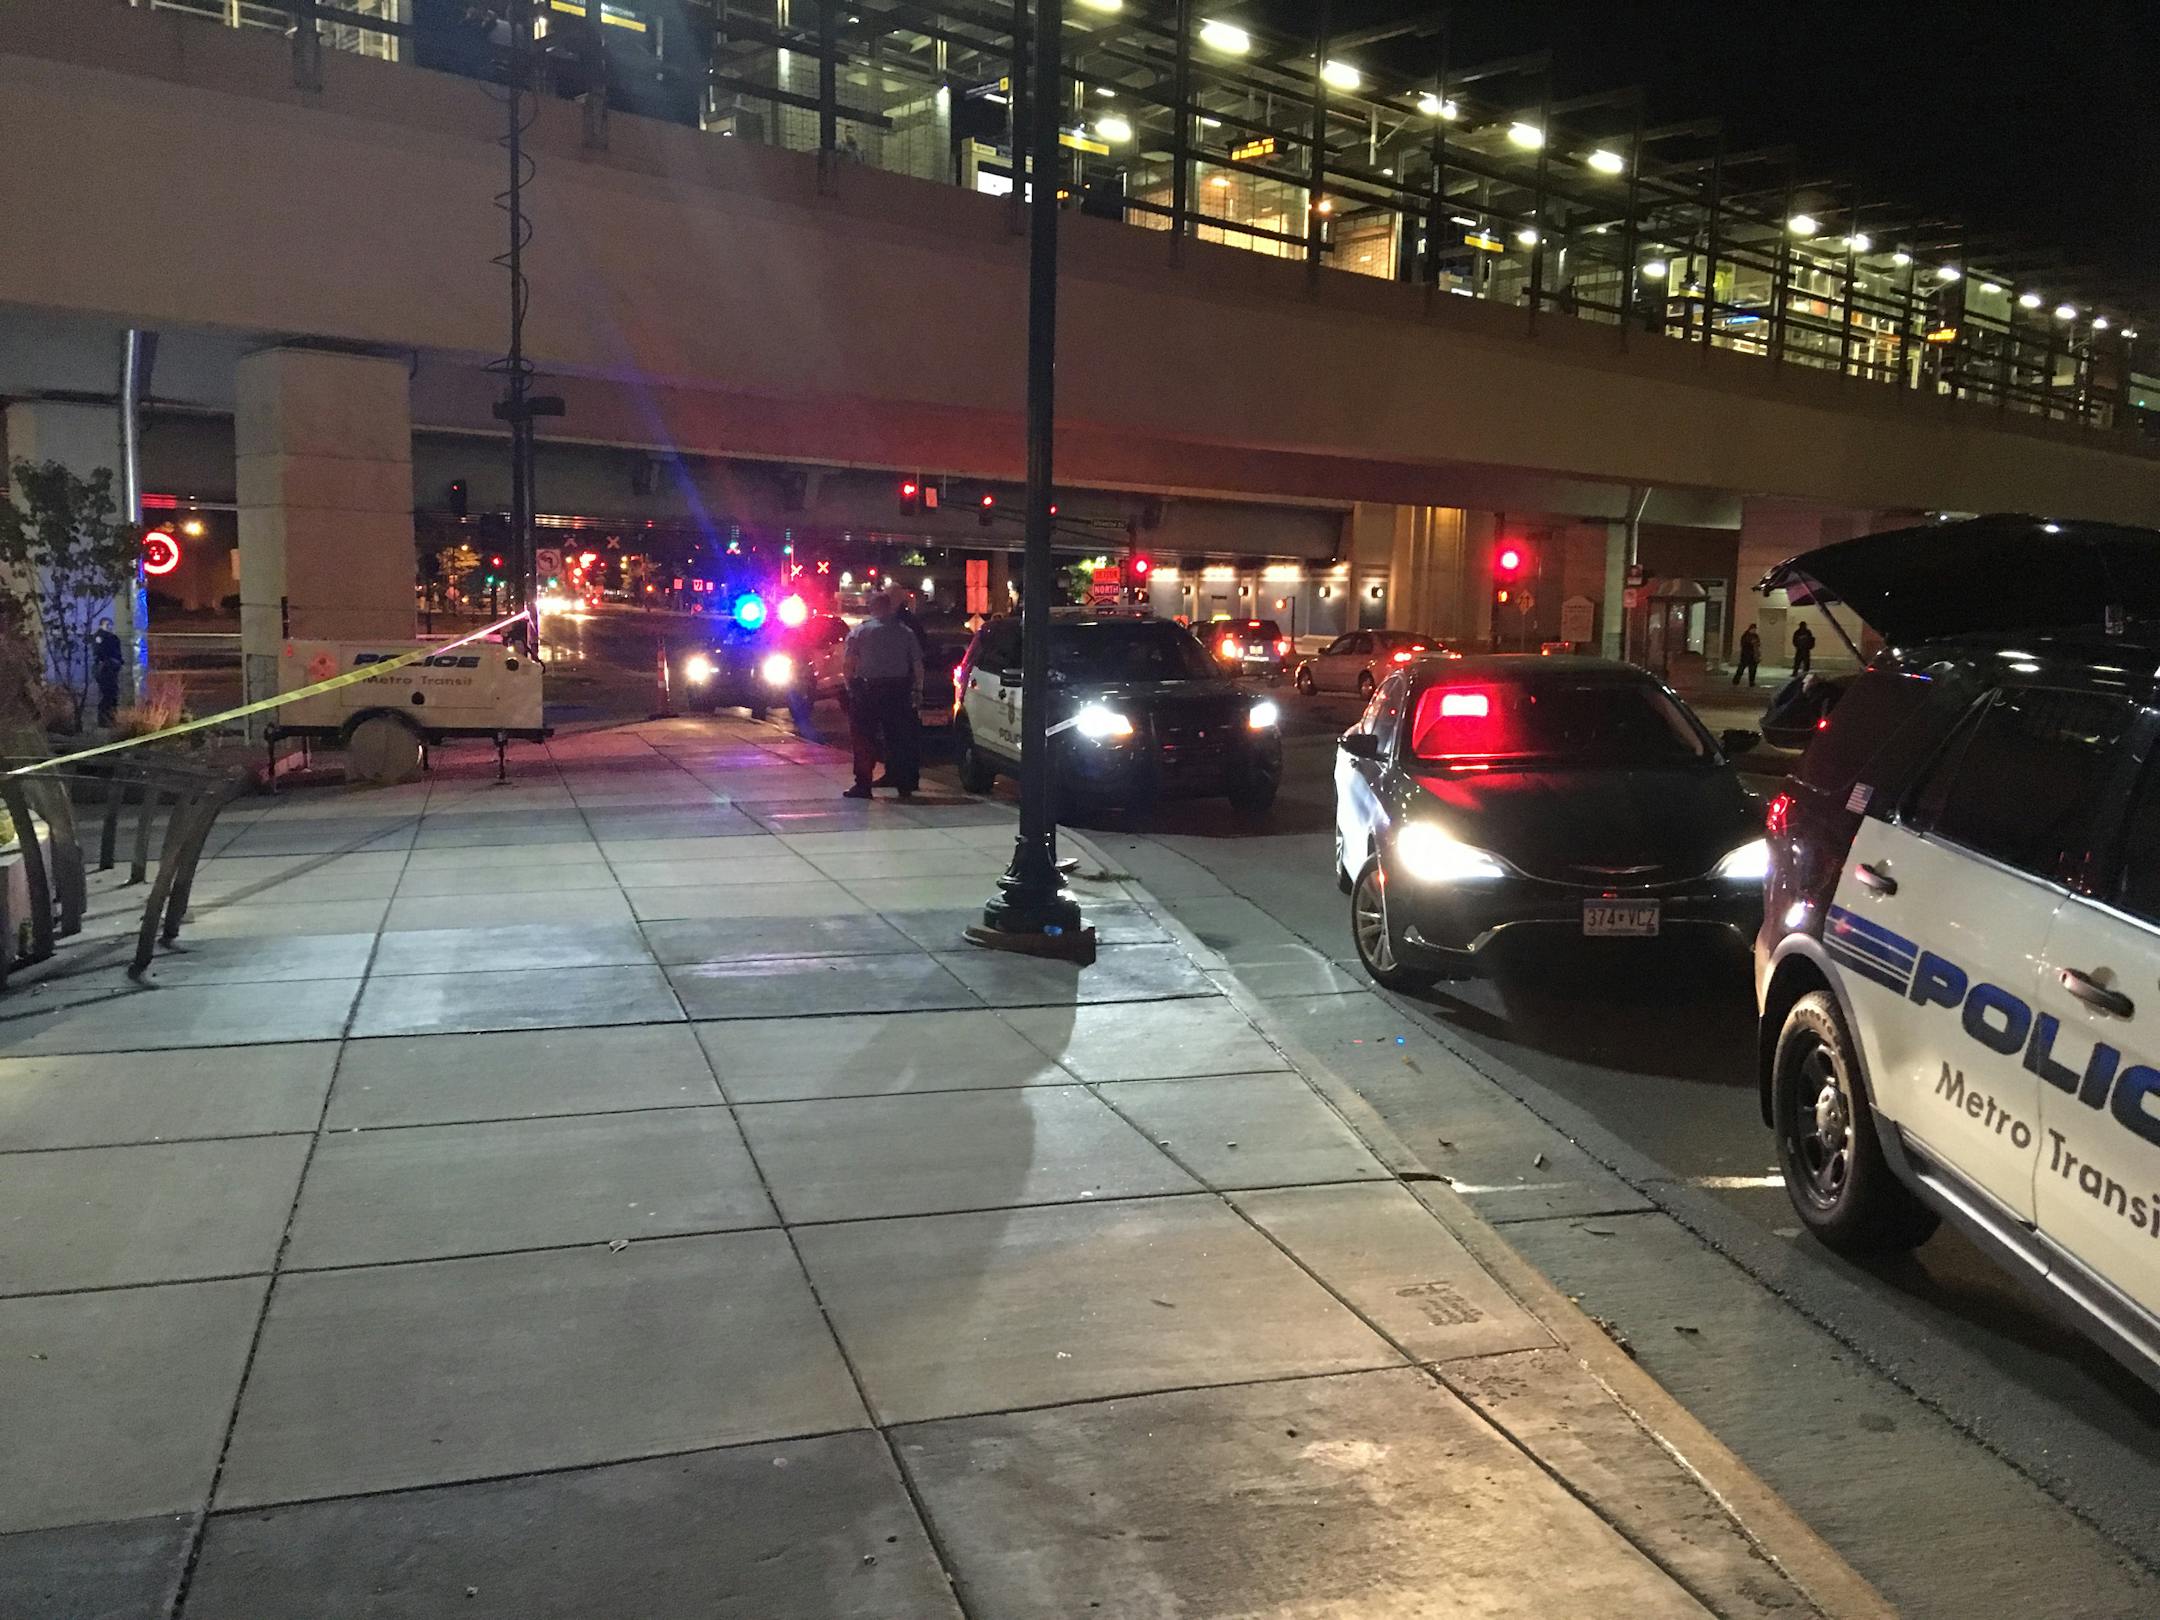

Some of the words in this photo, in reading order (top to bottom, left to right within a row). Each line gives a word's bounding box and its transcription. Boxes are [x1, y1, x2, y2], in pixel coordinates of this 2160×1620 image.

[1094, 585, 1119, 595] NORTH
[363, 675, 413, 685] Metro
[420, 675, 473, 686] Transit
[1909, 950, 2160, 1148] POLIC
[1935, 1060, 2032, 1150] Metro
[2048, 1127, 2160, 1239] Transi
